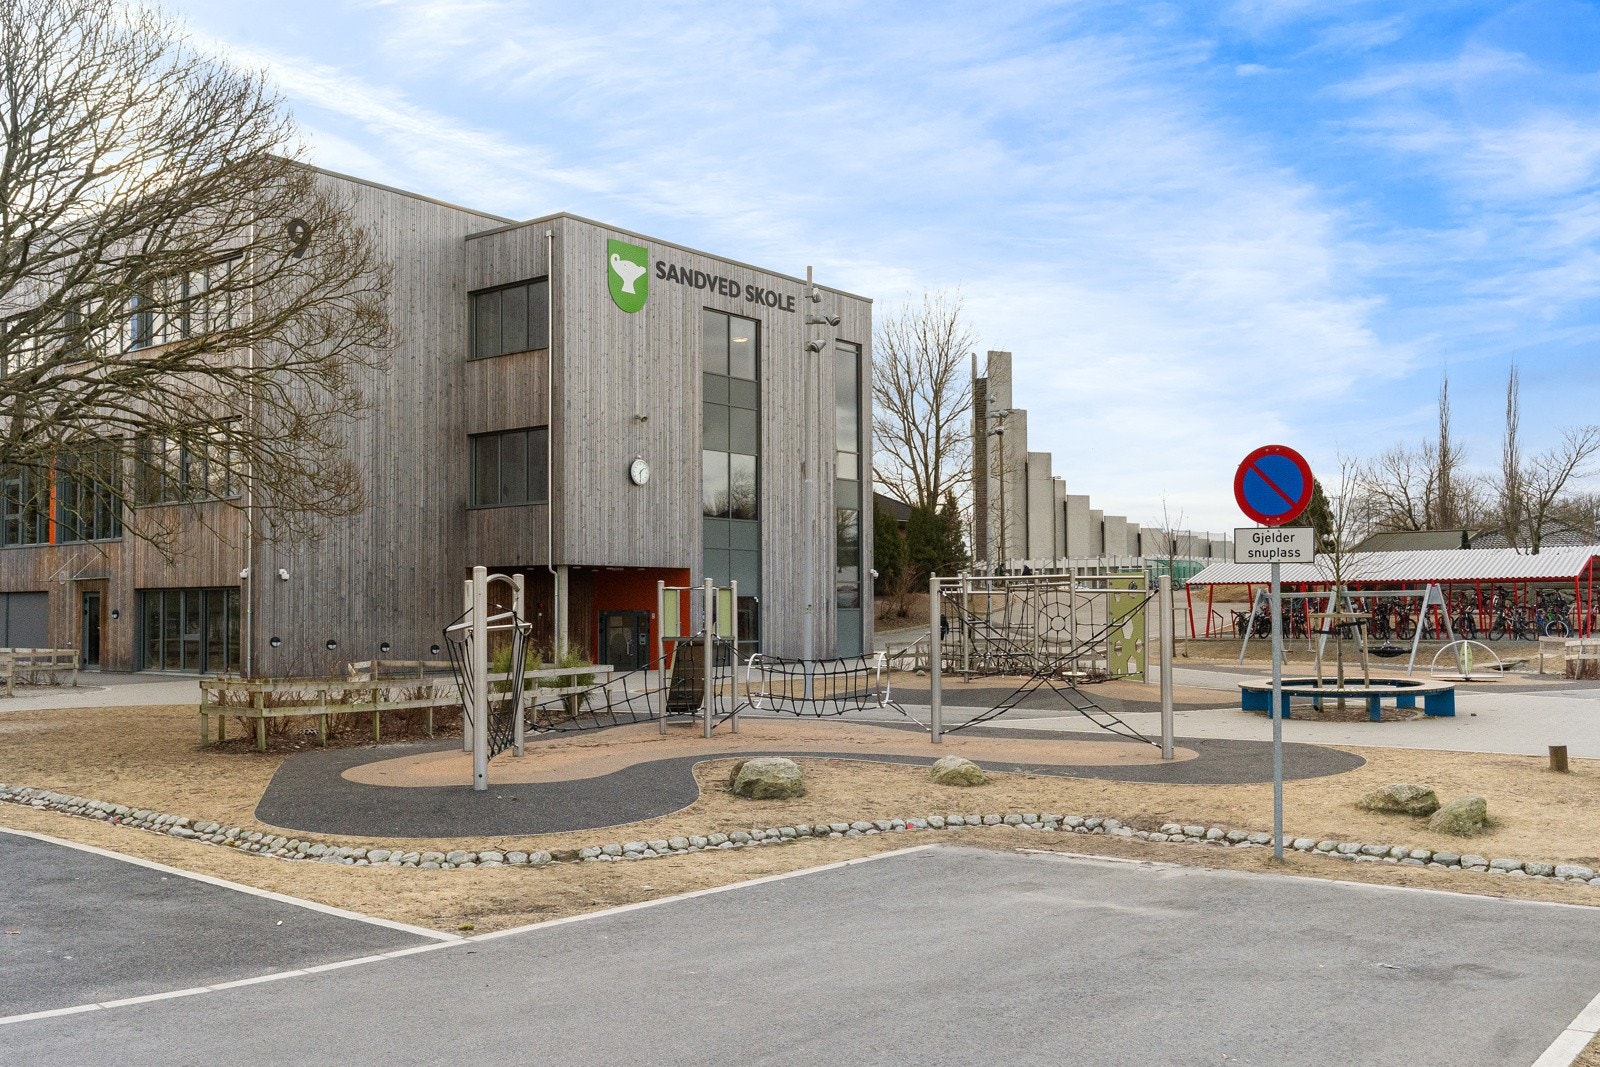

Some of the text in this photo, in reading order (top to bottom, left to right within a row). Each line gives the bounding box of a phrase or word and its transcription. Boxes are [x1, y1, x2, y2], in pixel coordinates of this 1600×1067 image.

[287, 218, 312, 259] 9
[655, 260, 796, 313] SANDVED SKOLE
[1252, 532, 1296, 546] Gjelder
[1248, 547, 1301, 560] snuplass
